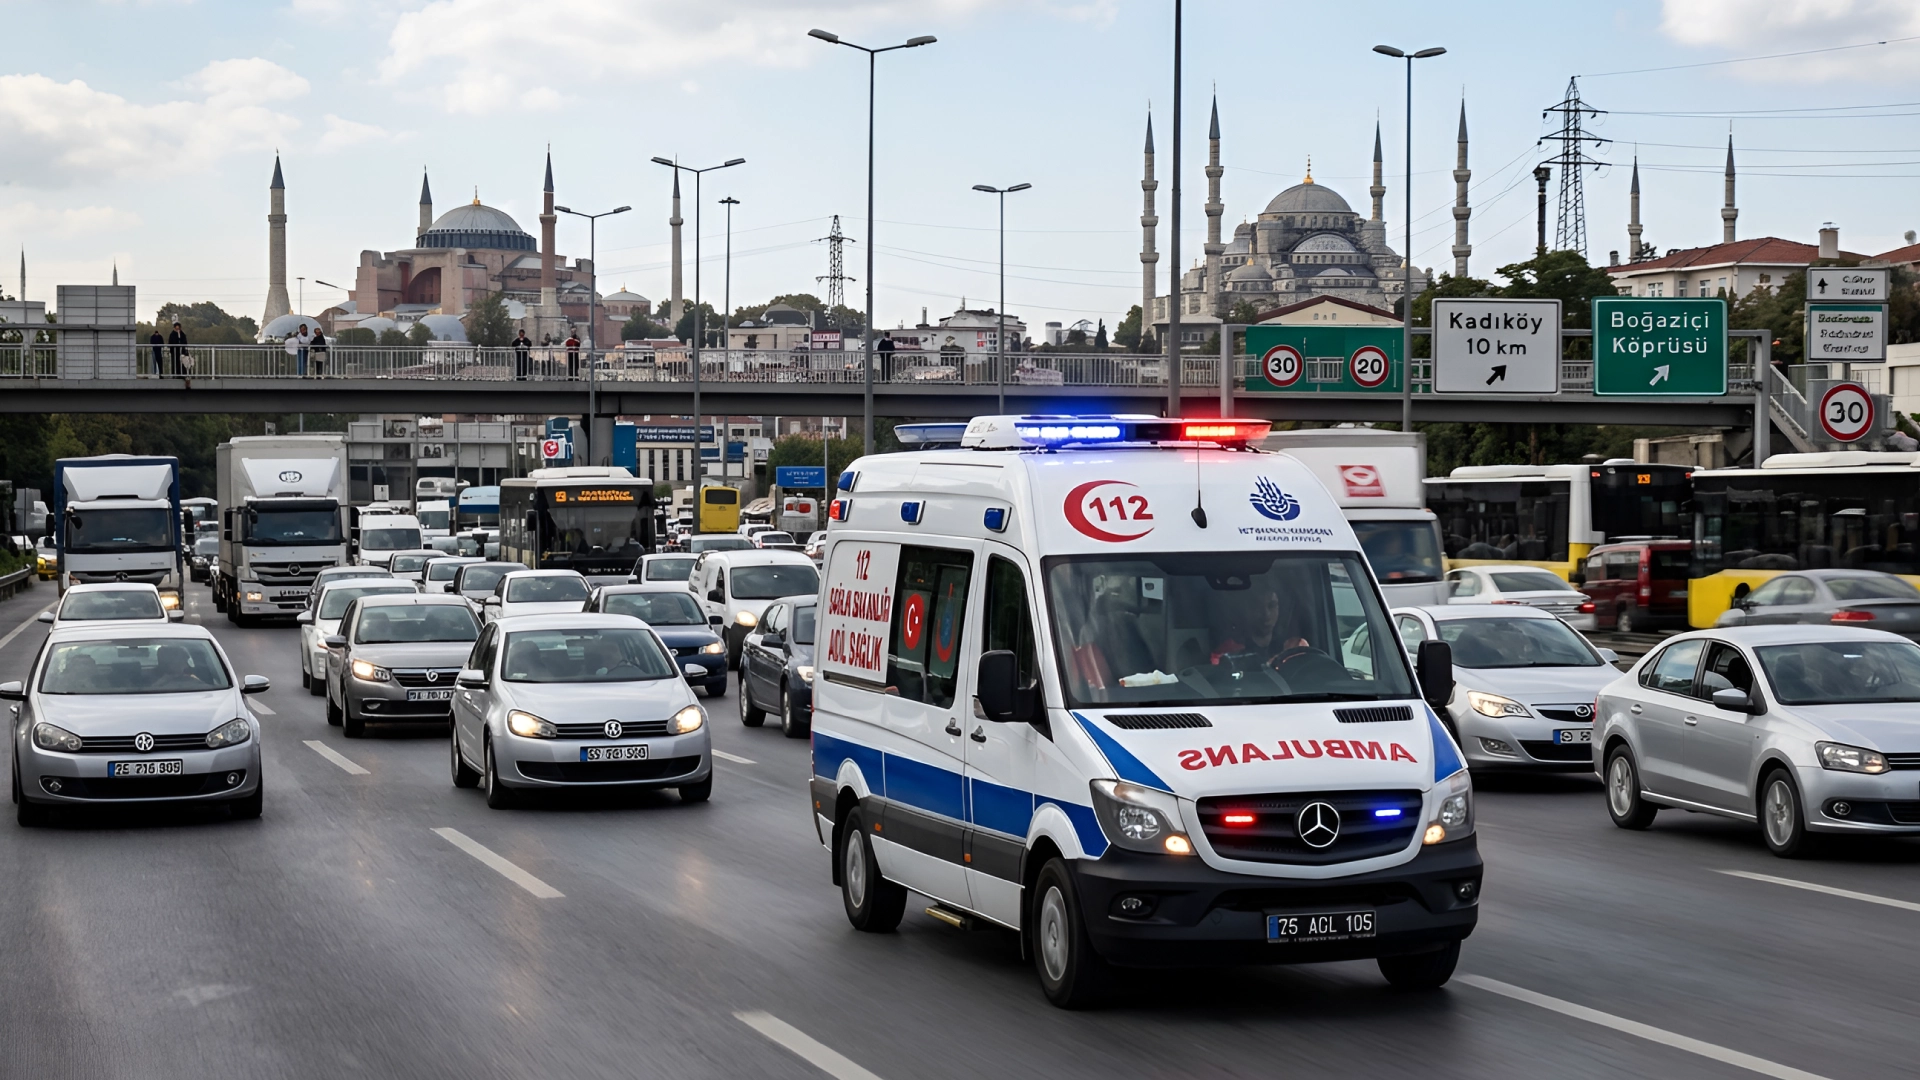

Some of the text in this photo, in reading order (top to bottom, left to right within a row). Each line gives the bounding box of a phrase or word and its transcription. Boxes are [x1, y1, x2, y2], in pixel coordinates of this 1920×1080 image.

[1449, 312, 1542, 335] Kadıköy
[1611, 311, 1709, 332] Boğaziçi
[1466, 338, 1526, 354] 10 km
[1612, 337, 1707, 358] Köprüsü
[1270, 357, 1295, 373] 30
[1357, 358, 1382, 374] 20
[1829, 401, 1863, 424] 30
[1089, 495, 1154, 521] 112
[856, 550, 871, 580] 112
[1345, 913, 1372, 932] 105
